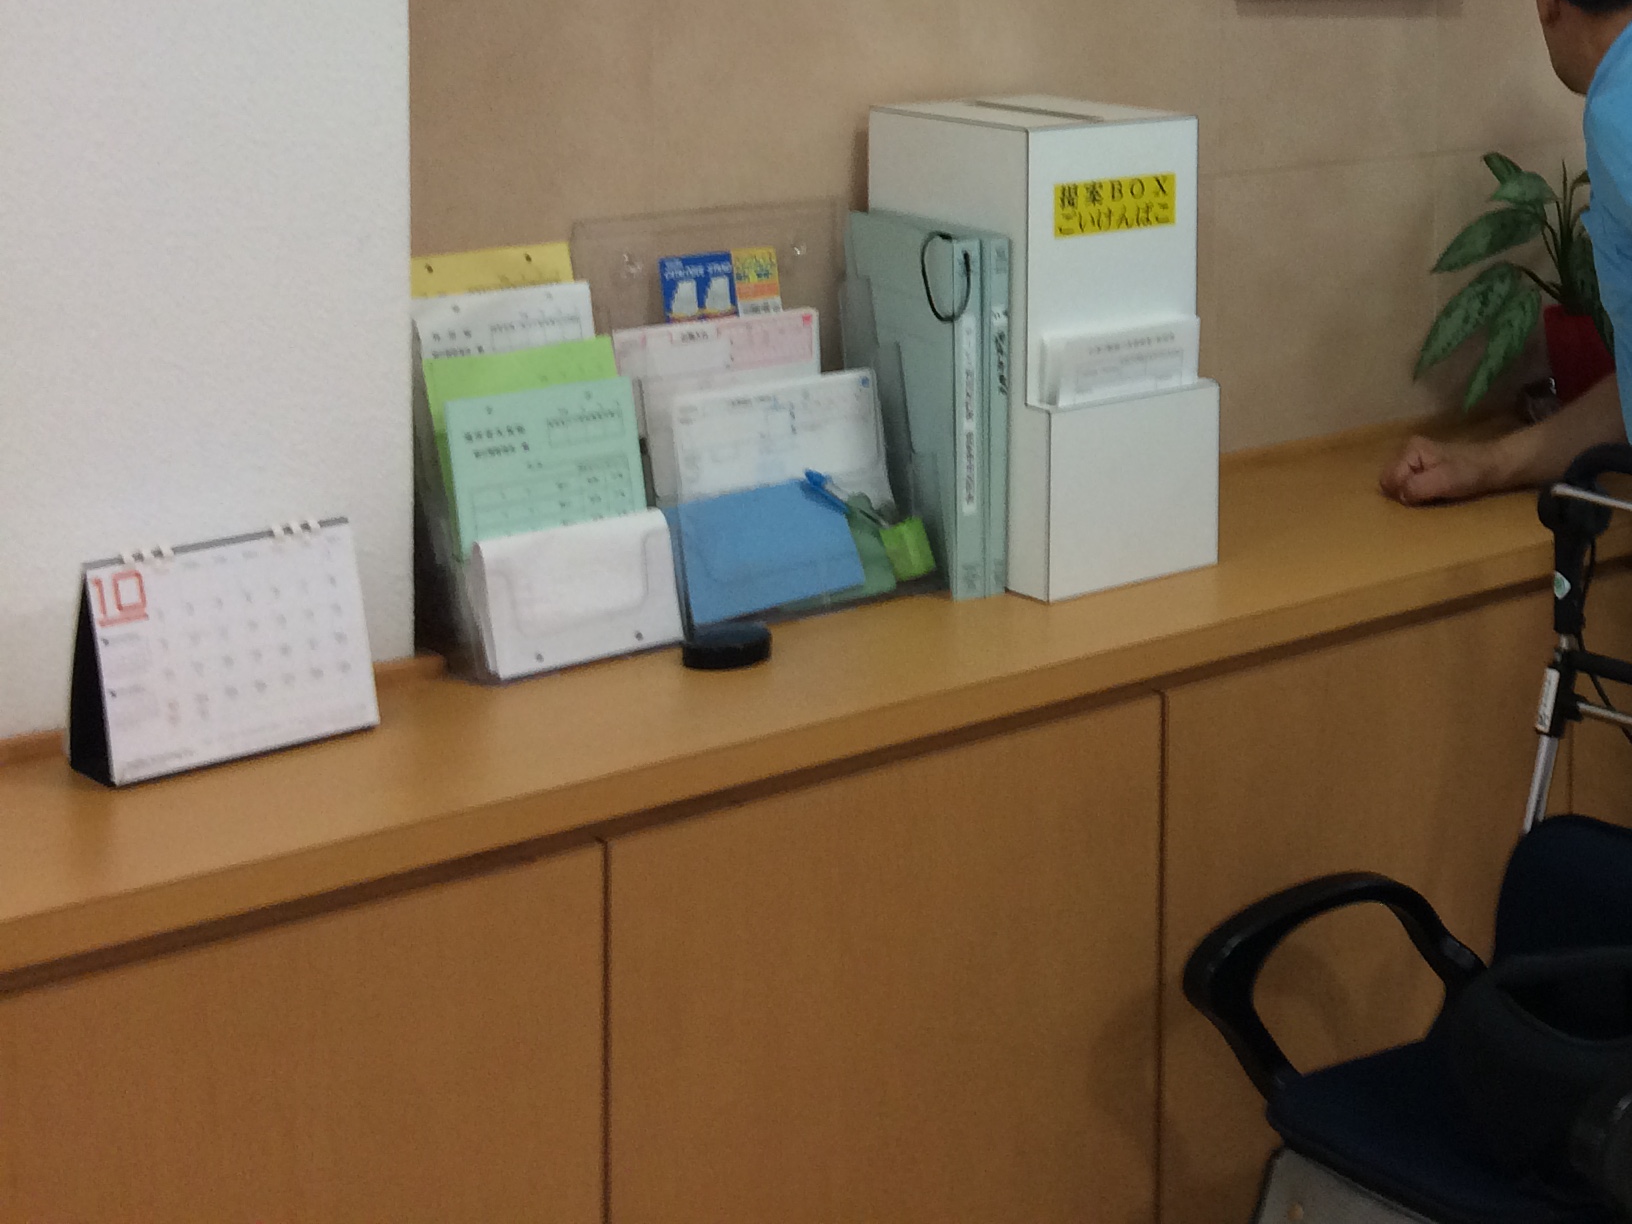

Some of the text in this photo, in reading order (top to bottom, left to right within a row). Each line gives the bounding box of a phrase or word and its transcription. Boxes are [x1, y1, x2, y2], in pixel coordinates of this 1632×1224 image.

[1059, 201, 1170, 235] ごいけんばこ
[91, 570, 147, 617] 10
